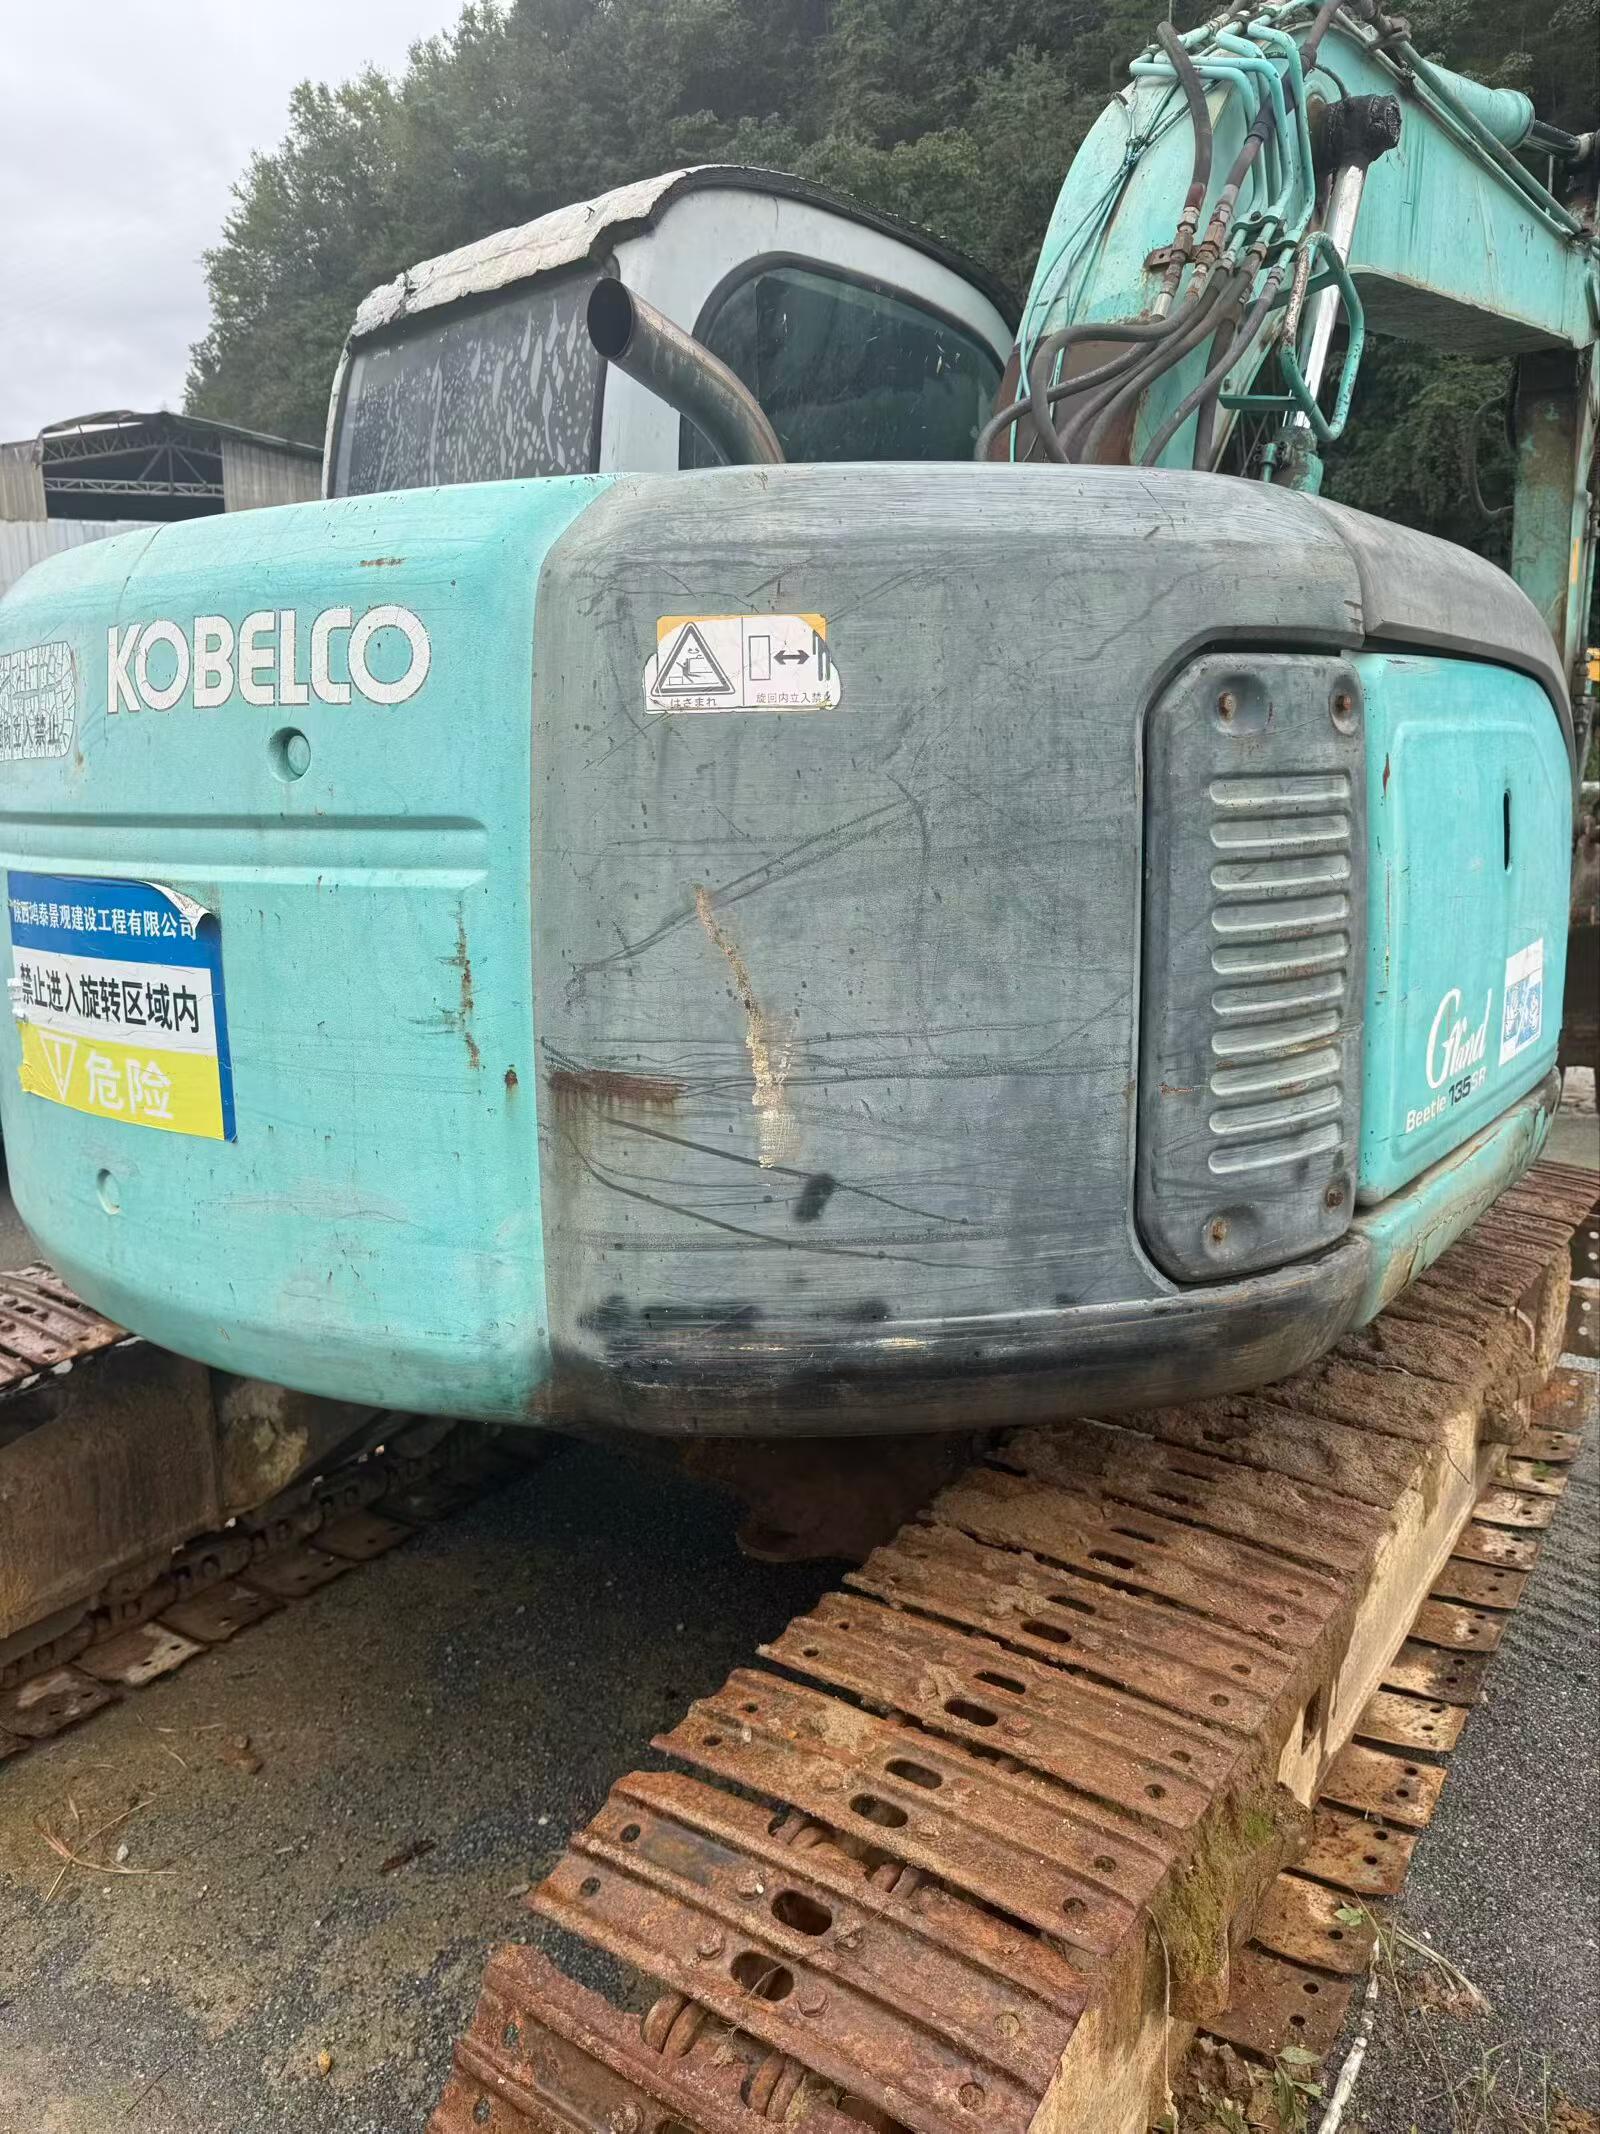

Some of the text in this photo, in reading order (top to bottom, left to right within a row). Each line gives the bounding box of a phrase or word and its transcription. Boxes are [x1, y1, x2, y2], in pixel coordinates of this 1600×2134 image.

[106, 603, 432, 714] KOBELCO
[0, 712, 61, 748] 内立入禁止
[20, 962, 200, 1034] 禁止进入旋转区域内
[86, 1049, 174, 1120] 危险
[1405, 1096, 1447, 1133] Beetle
